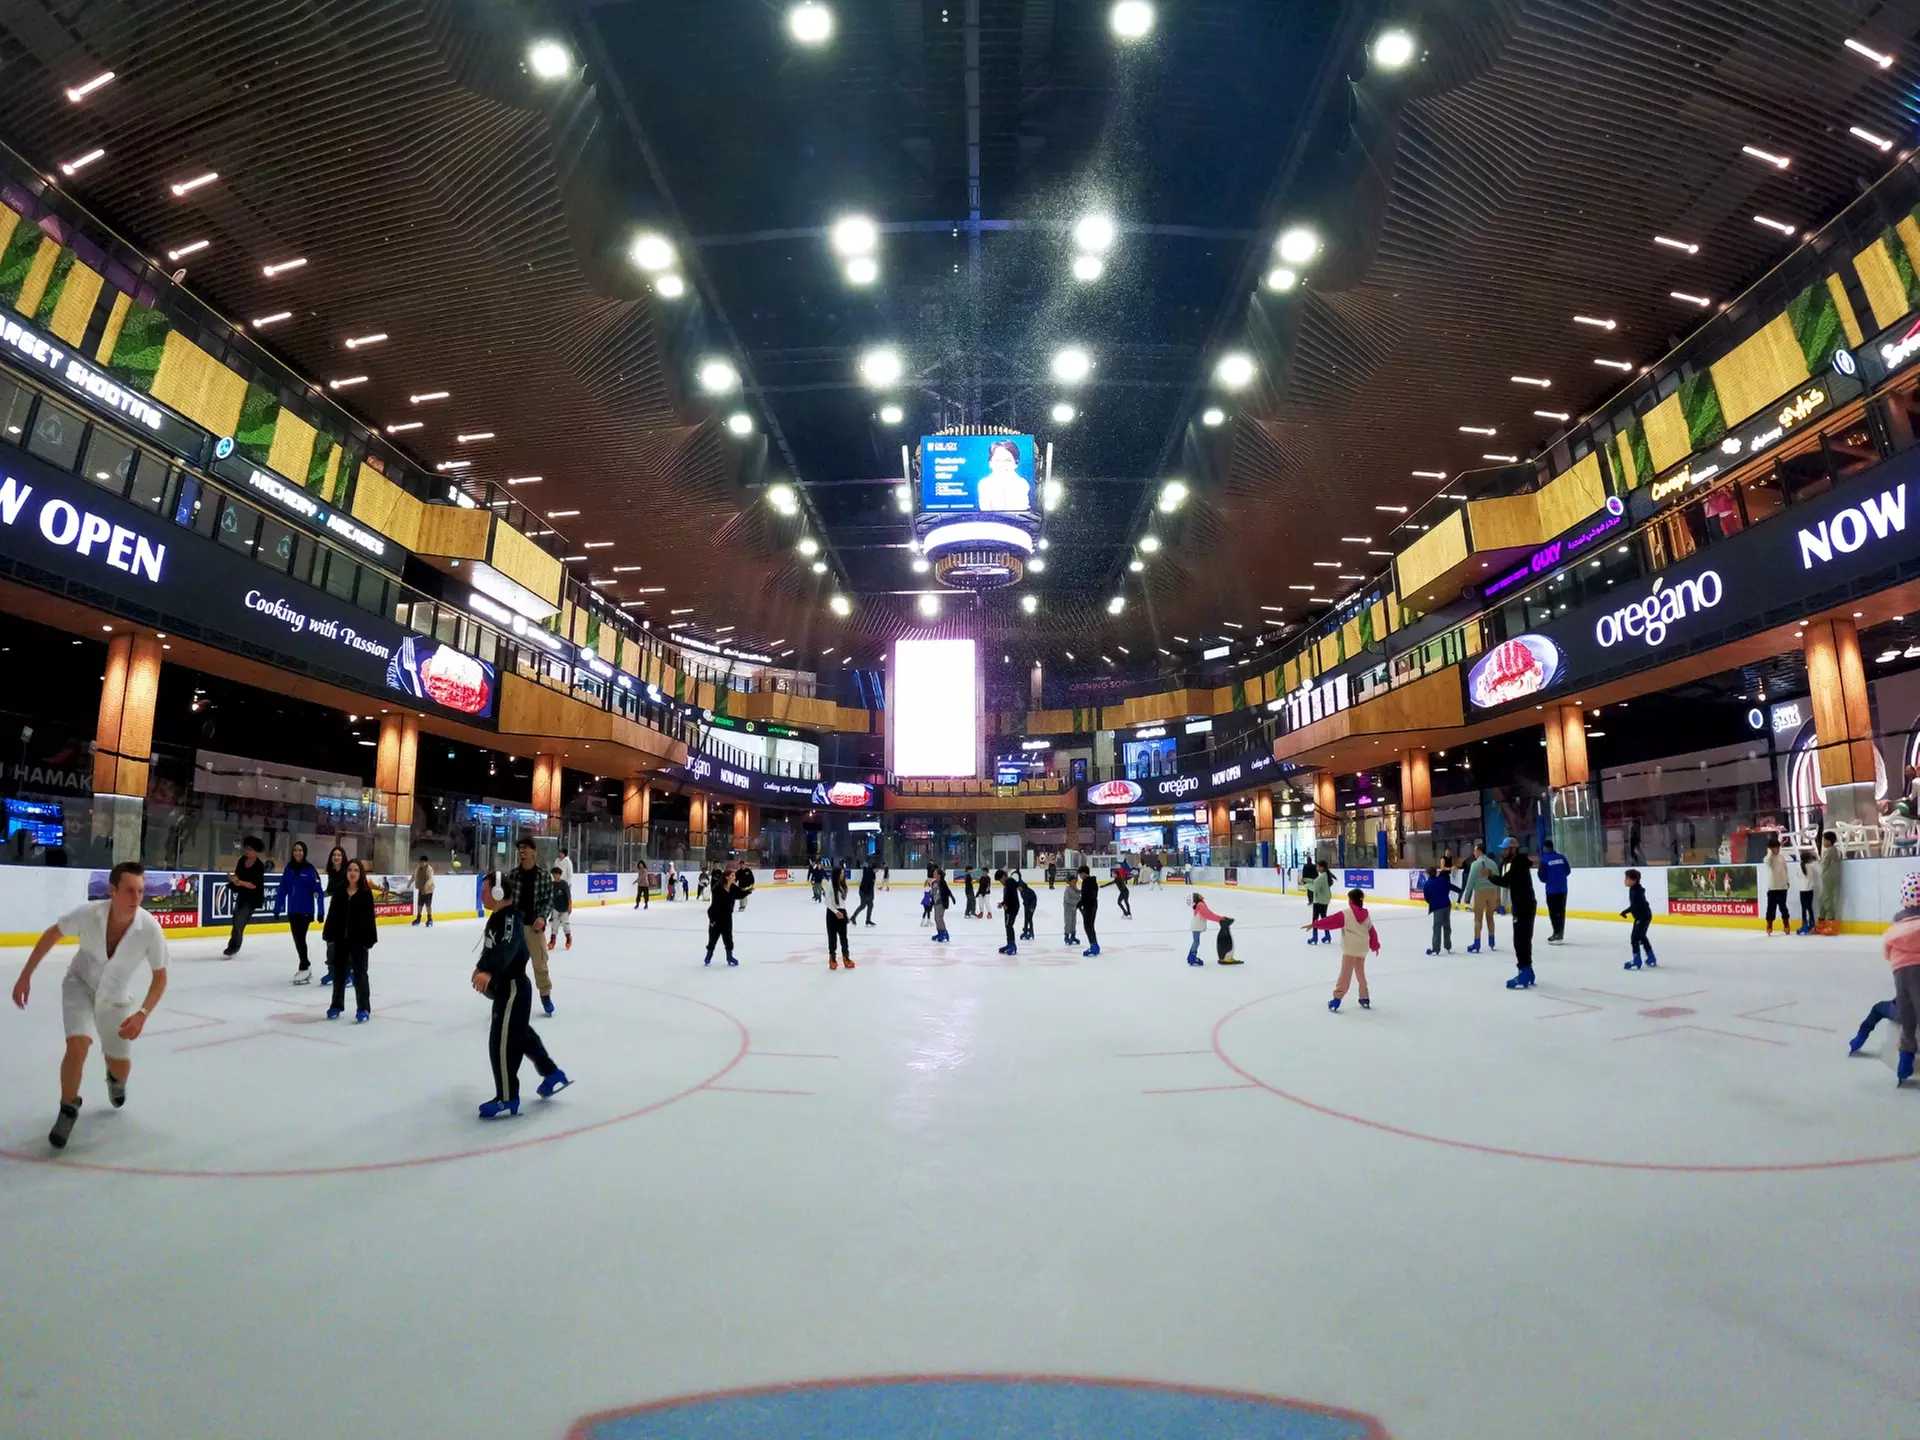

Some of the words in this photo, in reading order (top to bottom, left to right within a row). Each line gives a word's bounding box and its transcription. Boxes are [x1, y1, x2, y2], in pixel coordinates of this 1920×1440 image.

[65, 360, 163, 430] SHOOTING
[39, 498, 166, 584] OPEN
[1797, 483, 1907, 570] NOW
[244, 589, 305, 634] Cooking
[308, 618, 338, 641] with
[340, 628, 390, 660] Passion
[720, 767, 735, 785] NOW
[734, 772, 750, 790] OPEN
[763, 781, 781, 794] Cooking
[781, 783, 792, 793] with
[792, 783, 812, 795] Passion
[1212, 769, 1225, 787] NOW
[1225, 764, 1241, 783] OPEN
[1672, 902, 1754, 914] LEADERSPORTS.COM
